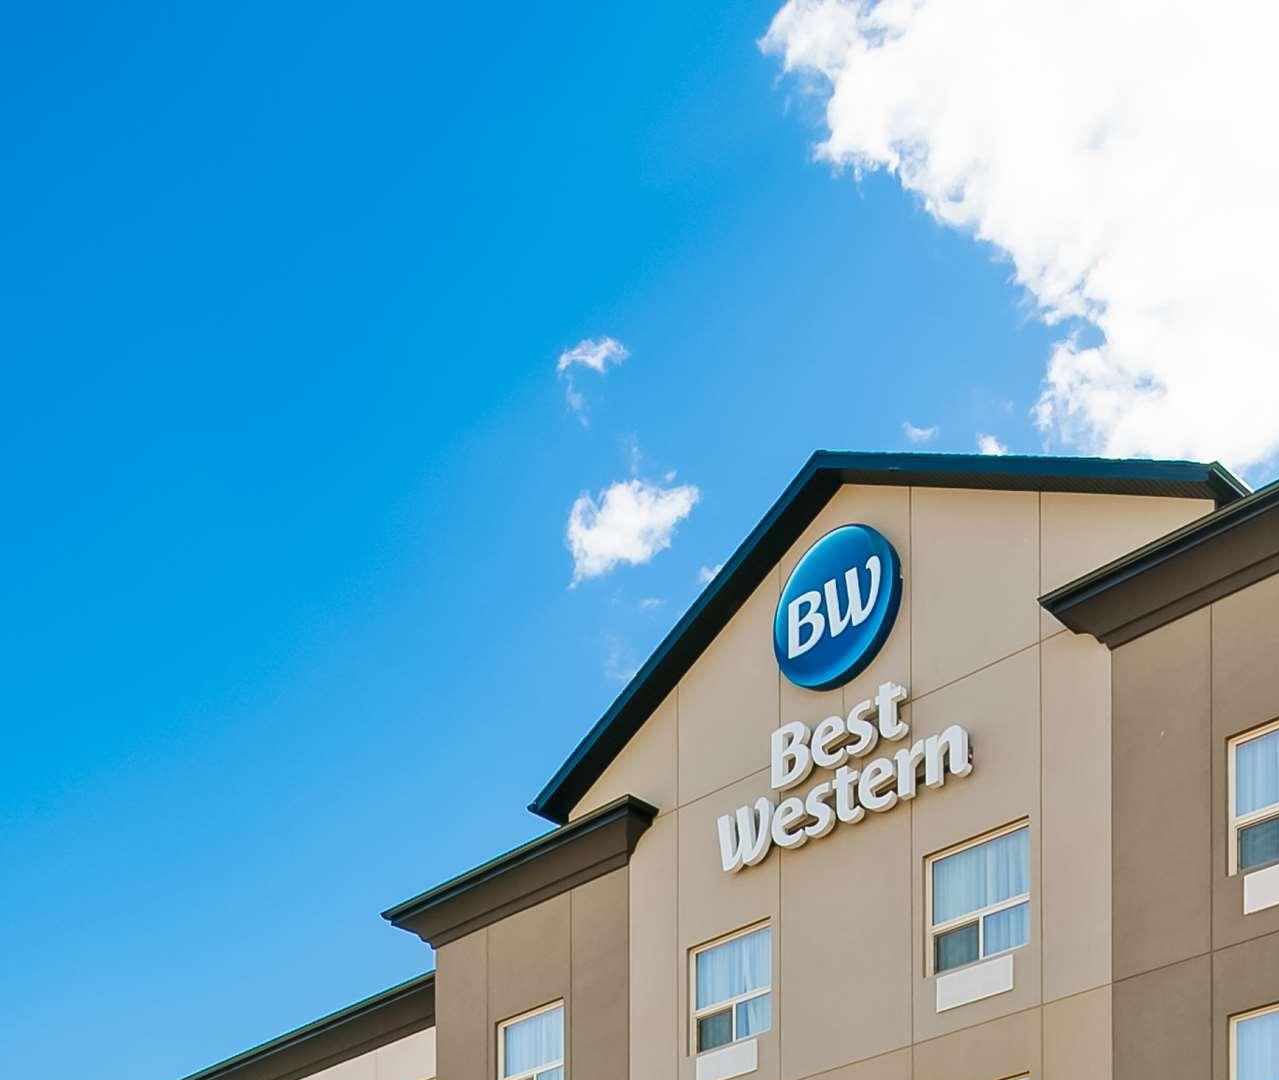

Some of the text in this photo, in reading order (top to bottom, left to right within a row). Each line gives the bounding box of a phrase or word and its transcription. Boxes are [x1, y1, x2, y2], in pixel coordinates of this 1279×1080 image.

[788, 555, 881, 660] BW
[771, 681, 909, 791] Best
[717, 725, 973, 873] Western
